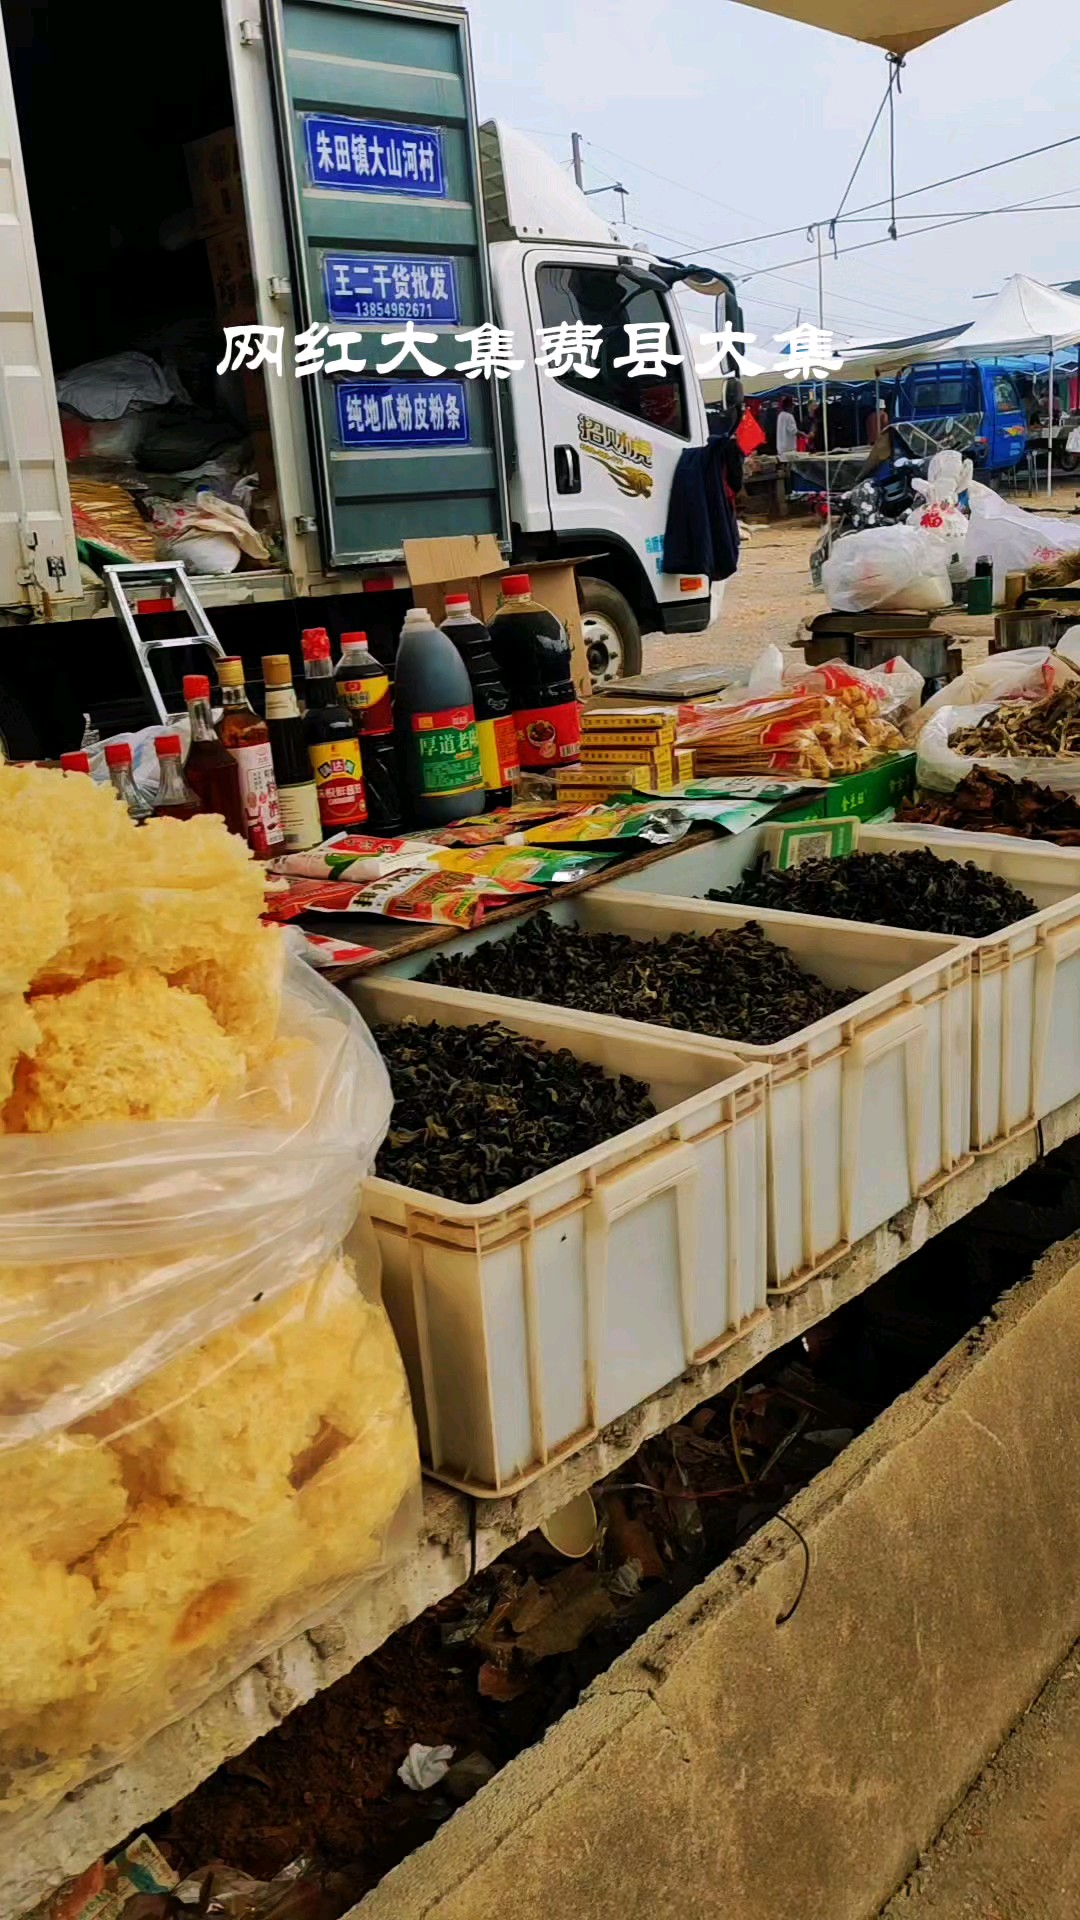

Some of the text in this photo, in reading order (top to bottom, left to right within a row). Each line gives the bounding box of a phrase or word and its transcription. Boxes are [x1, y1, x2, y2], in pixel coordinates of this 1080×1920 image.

[316, 131, 434, 182] 朱田镇大山河村
[333, 264, 448, 300] 王二干货批发
[355, 302, 432, 317] 13854962671
[346, 394, 461, 432] 纯地瓜粉皮粉条
